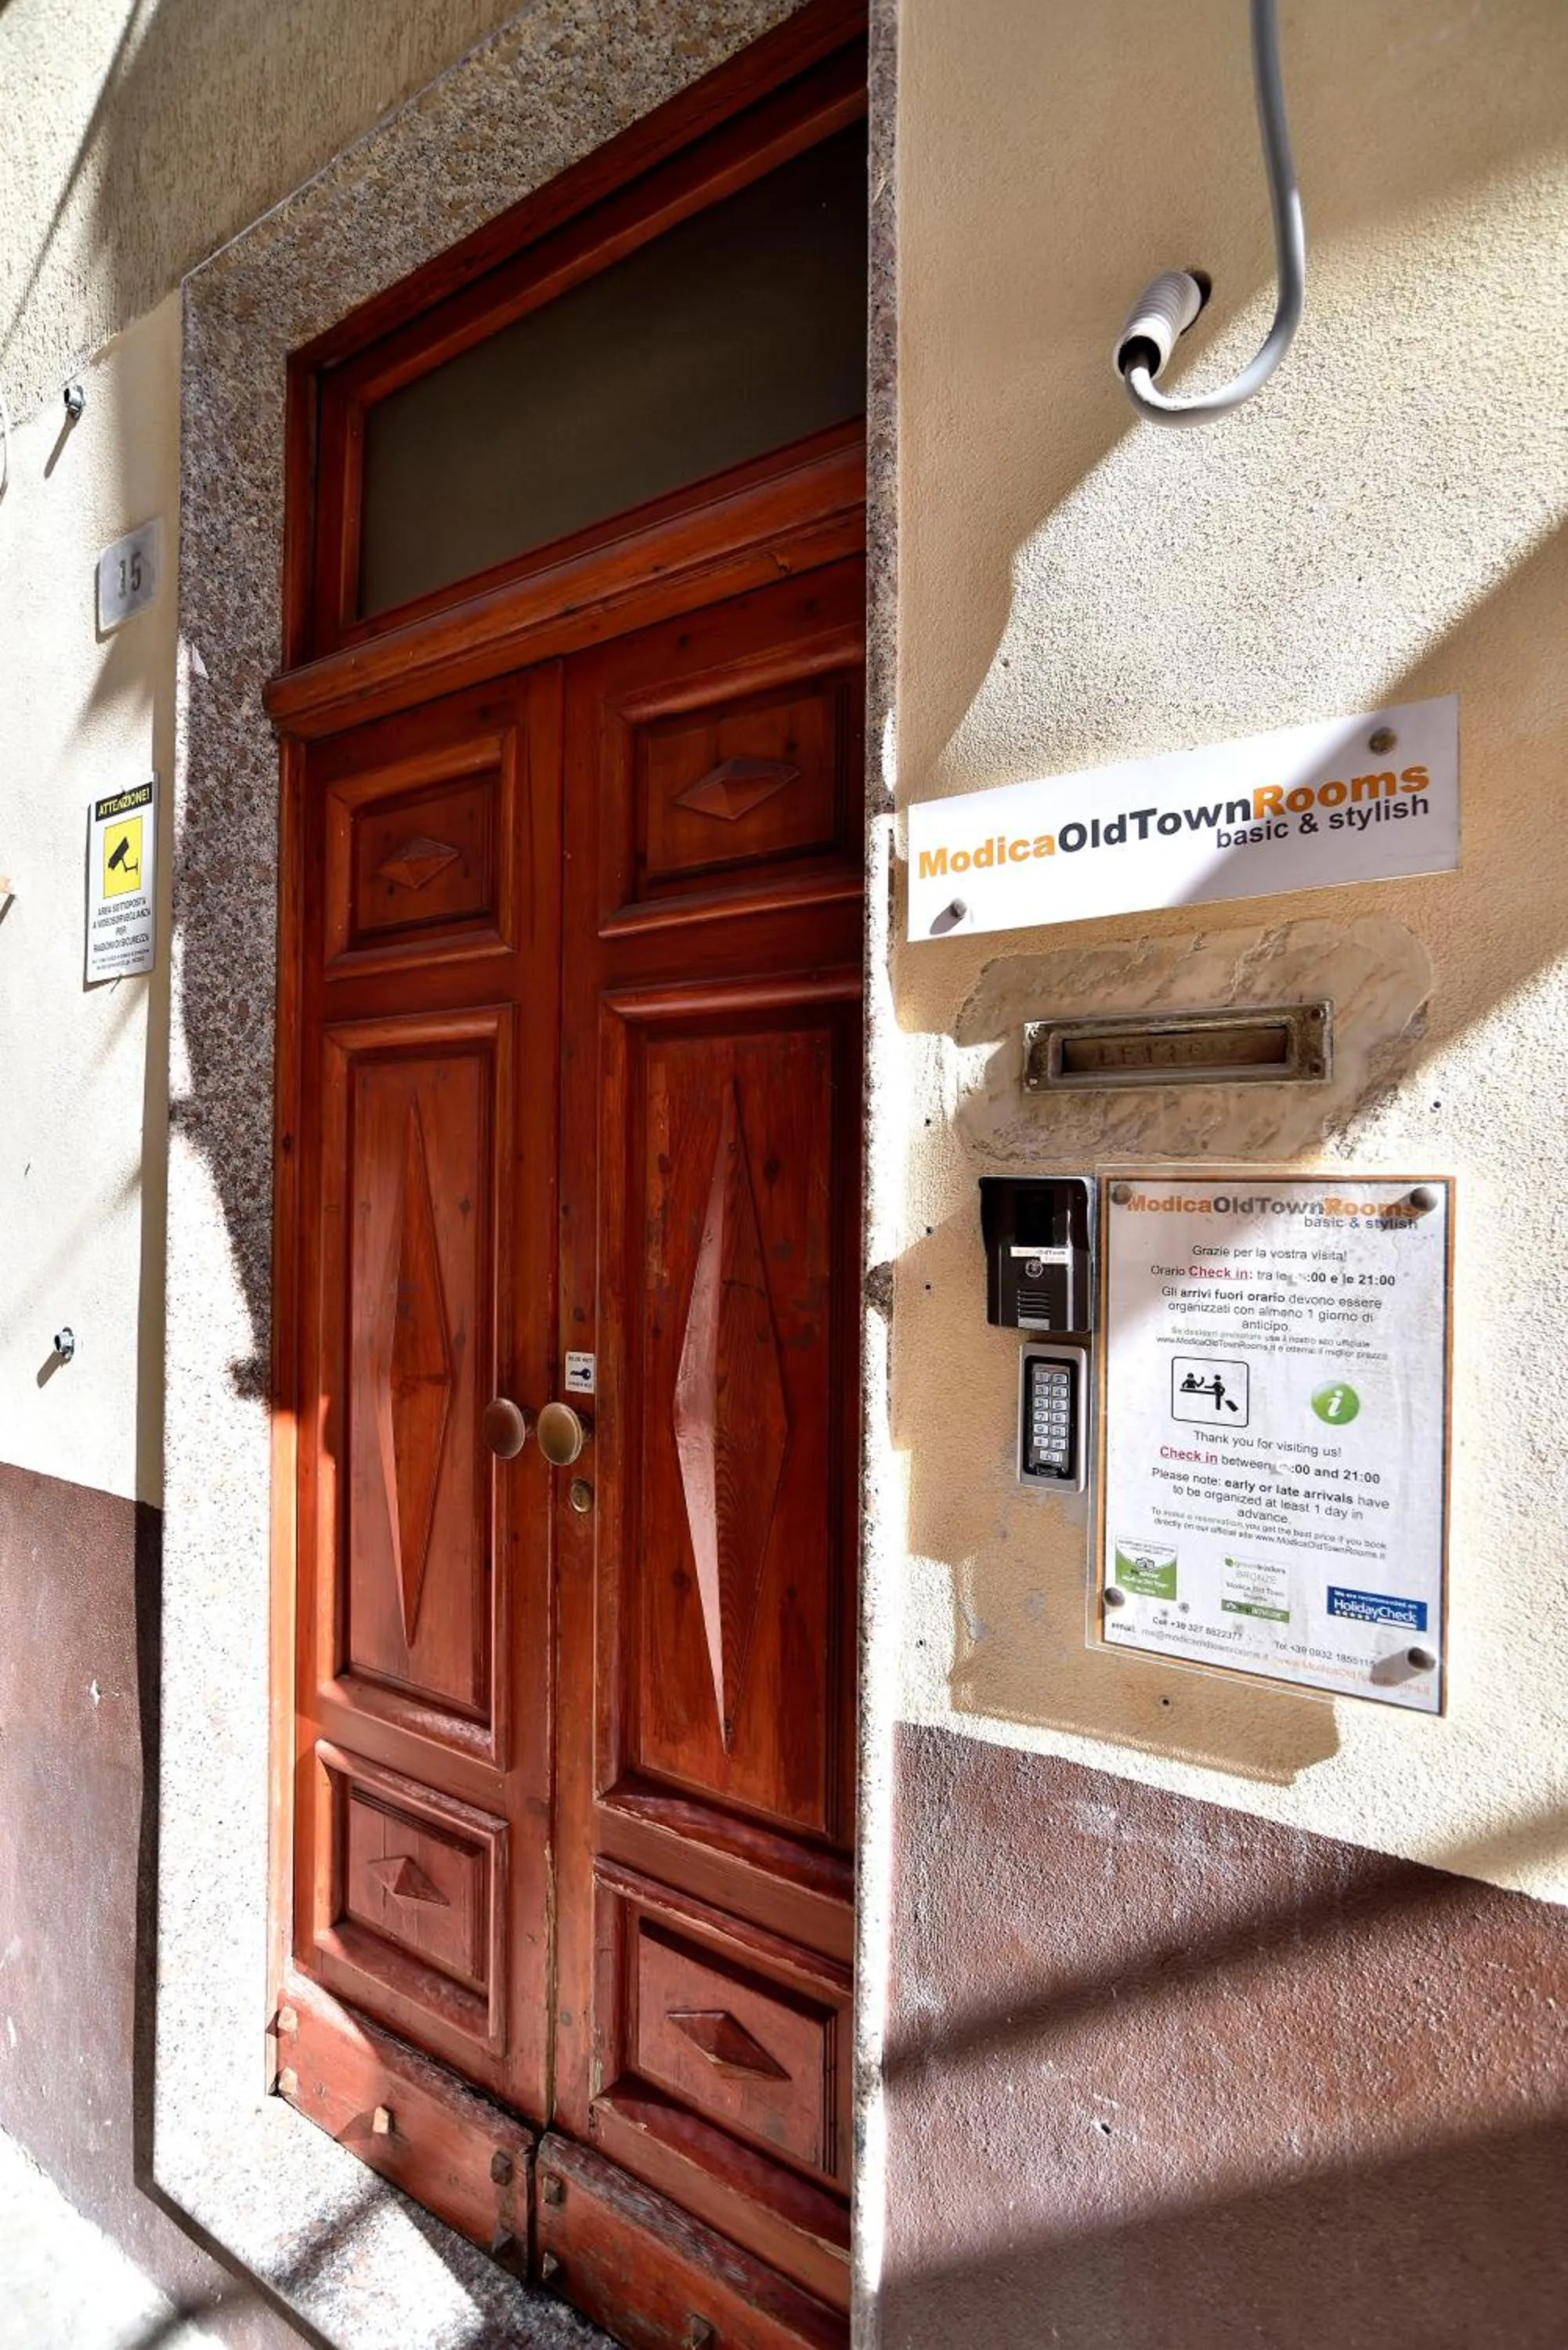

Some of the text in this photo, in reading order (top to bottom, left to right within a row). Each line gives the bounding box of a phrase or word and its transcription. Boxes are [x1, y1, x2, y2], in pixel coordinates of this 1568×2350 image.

[118, 551, 142, 599] 15
[917, 765, 1430, 880] ModicaOldTownRooms
[1216, 794, 1430, 849] basic & stylish
[1127, 1195, 1419, 1217] ModicaOldTownRooms
[1304, 1217, 1418, 1231] basic & stylish
[1191, 1245, 1347, 1262] Grazie per la vostra visita!
[1151, 1265, 1186, 1277] Orario
[1188, 1266, 1231, 1278] Check
[1235, 1268, 1253, 1280] in:
[1256, 1271, 1273, 1281] tra
[1342, 1274, 1354, 1284] le
[1358, 1274, 1396, 1286] 21:00
[1162, 1286, 1382, 1309] Gli arrivi fuori orario devono essere
[1168, 1301, 1230, 1314] organizzati
[1234, 1306, 1255, 1315] con
[1259, 1307, 1302, 1319] almeno
[1318, 1311, 1358, 1322] giorno
[1362, 1312, 1374, 1322] di
[1241, 1320, 1291, 1333] anticipo.
[1194, 1430, 1342, 1458] Thank you for visiting us!
[1160, 1446, 1201, 1462] Check
[1205, 1452, 1218, 1464] in
[1221, 1454, 1271, 1470] between
[1313, 1466, 1339, 1479] and
[1342, 1470, 1381, 1484] 21:00
[1152, 1467, 1390, 1509] Please note: early or late arrivals have
[1172, 1484, 1183, 1495] to
[1187, 1485, 1201, 1497] be
[1204, 1488, 1263, 1506] organized
[1265, 1497, 1277, 1508] at
[1281, 1499, 1310, 1513] least
[1324, 1506, 1349, 1520] day
[1351, 1509, 1364, 1520] in
[1237, 1508, 1292, 1524] advance.
[1334, 1597, 1417, 1623] HolidayCheck
[1187, 1623, 1204, 1633] 327
[1309, 1649, 1333, 1660] 0932
